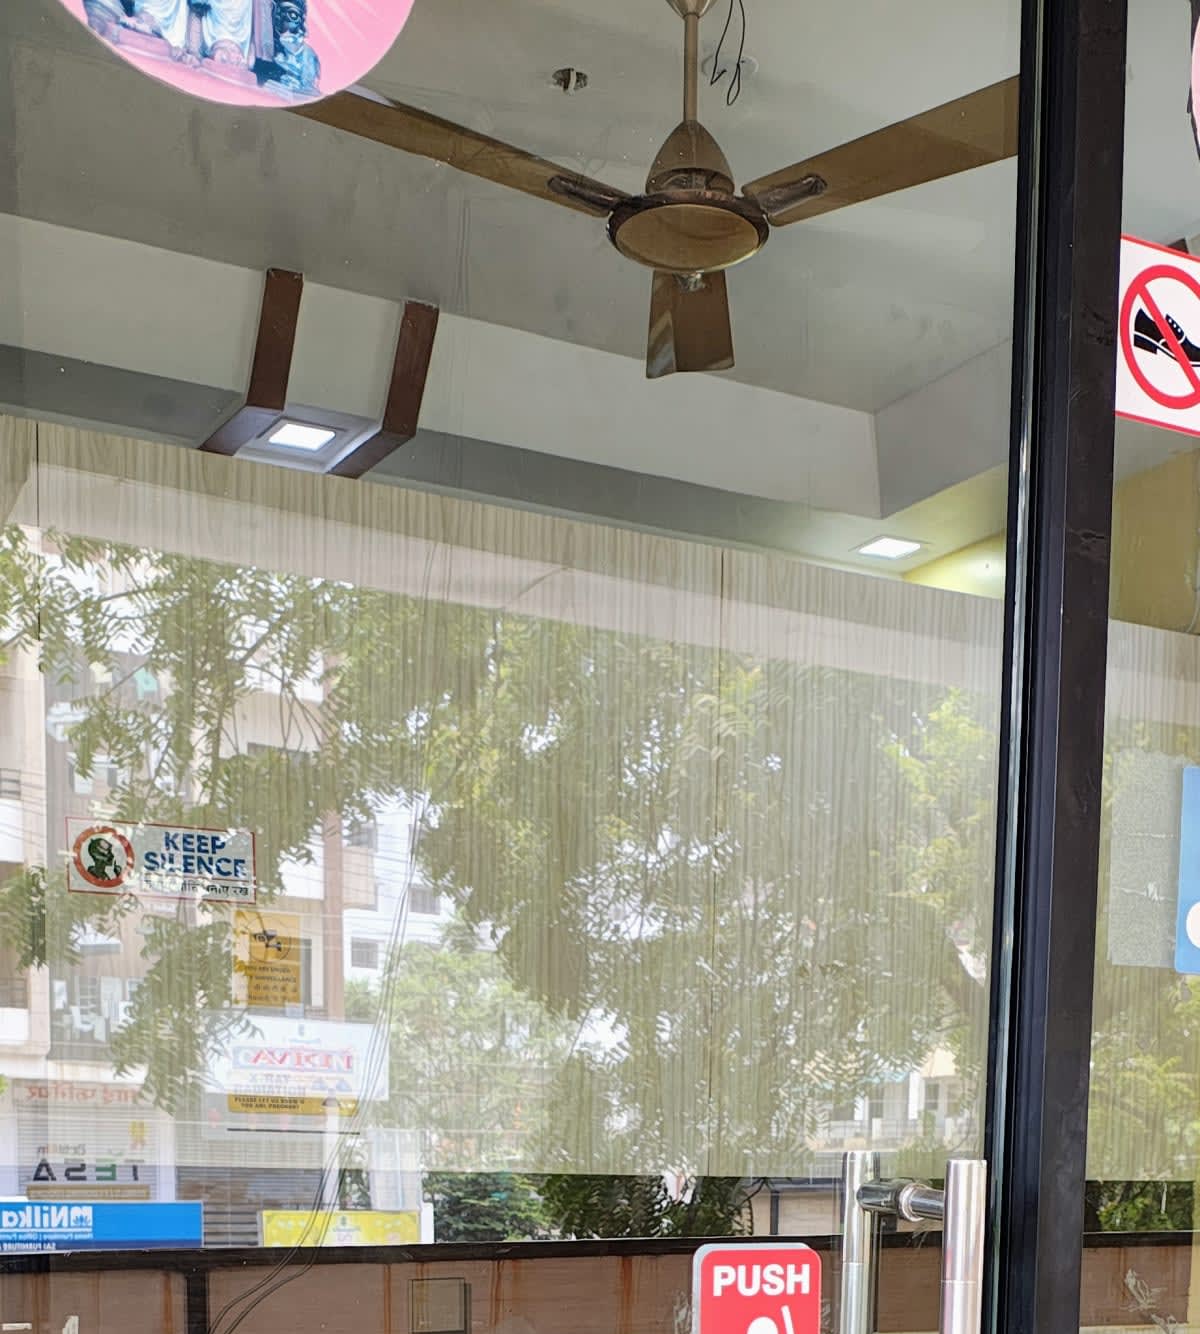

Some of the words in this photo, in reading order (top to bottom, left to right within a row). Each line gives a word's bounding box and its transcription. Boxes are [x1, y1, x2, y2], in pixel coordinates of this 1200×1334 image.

[164, 831, 226, 854] KEEP
[144, 851, 247, 877] SILENCE
[712, 1263, 811, 1297] PUSH
